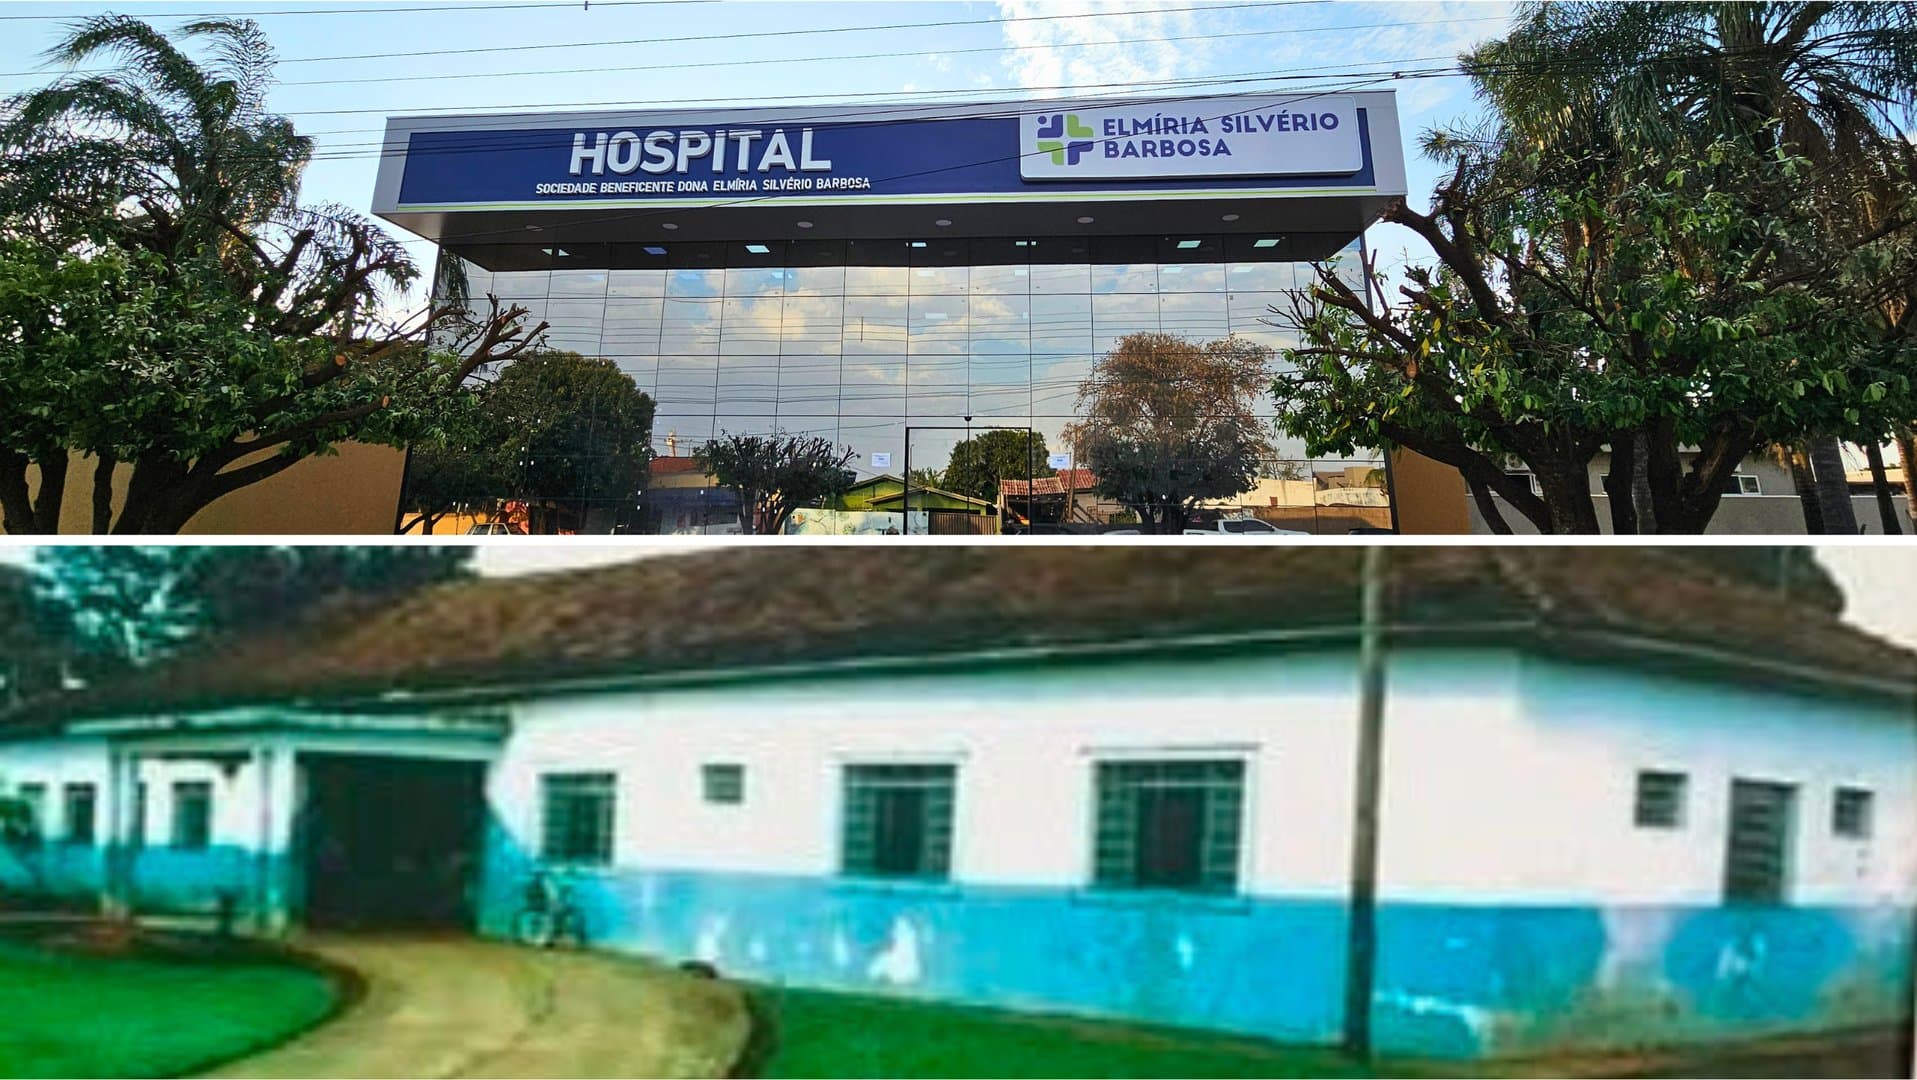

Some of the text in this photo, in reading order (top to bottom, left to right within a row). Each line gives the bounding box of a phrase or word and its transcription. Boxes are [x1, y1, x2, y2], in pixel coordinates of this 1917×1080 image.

[1103, 110, 1339, 136] ELMÍRIA SILVÉRIO
[569, 128, 832, 175] HOSPITAL
[1104, 138, 1232, 159] BARBOSA
[536, 177, 871, 195] SOCIEDADE BENEFICENTE DONA ELMÍRIA SILVÉRIO BARBOSA
